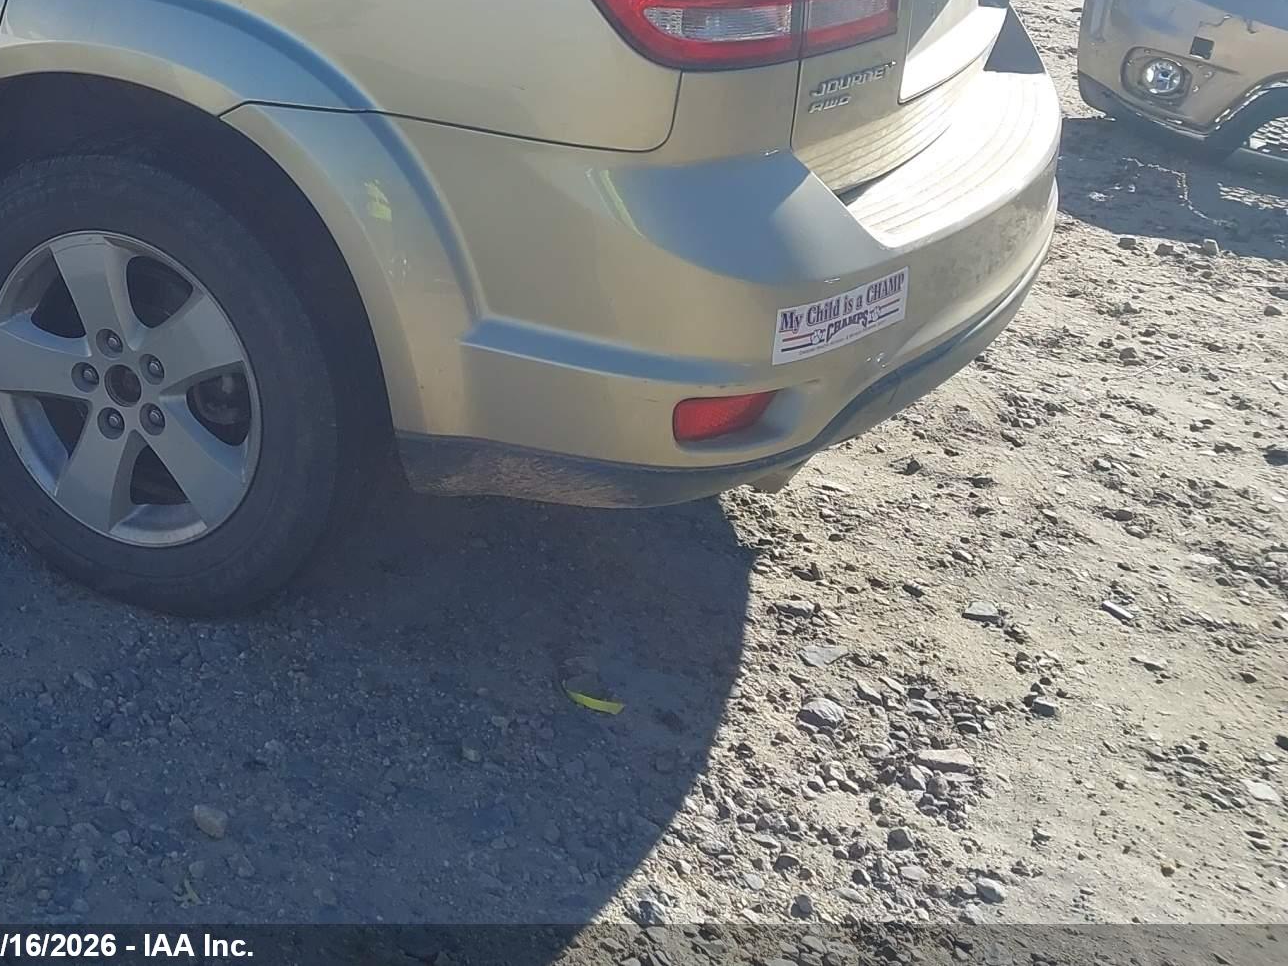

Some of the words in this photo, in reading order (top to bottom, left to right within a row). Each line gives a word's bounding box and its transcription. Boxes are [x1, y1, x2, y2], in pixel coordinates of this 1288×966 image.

[808, 95, 851, 114] AWD
[779, 310, 803, 334] My
[806, 296, 840, 326] Child
[843, 294, 853, 315] is
[855, 294, 863, 310] a
[866, 273, 905, 305] CHAMP
[825, 309, 869, 342] CHAMPS
